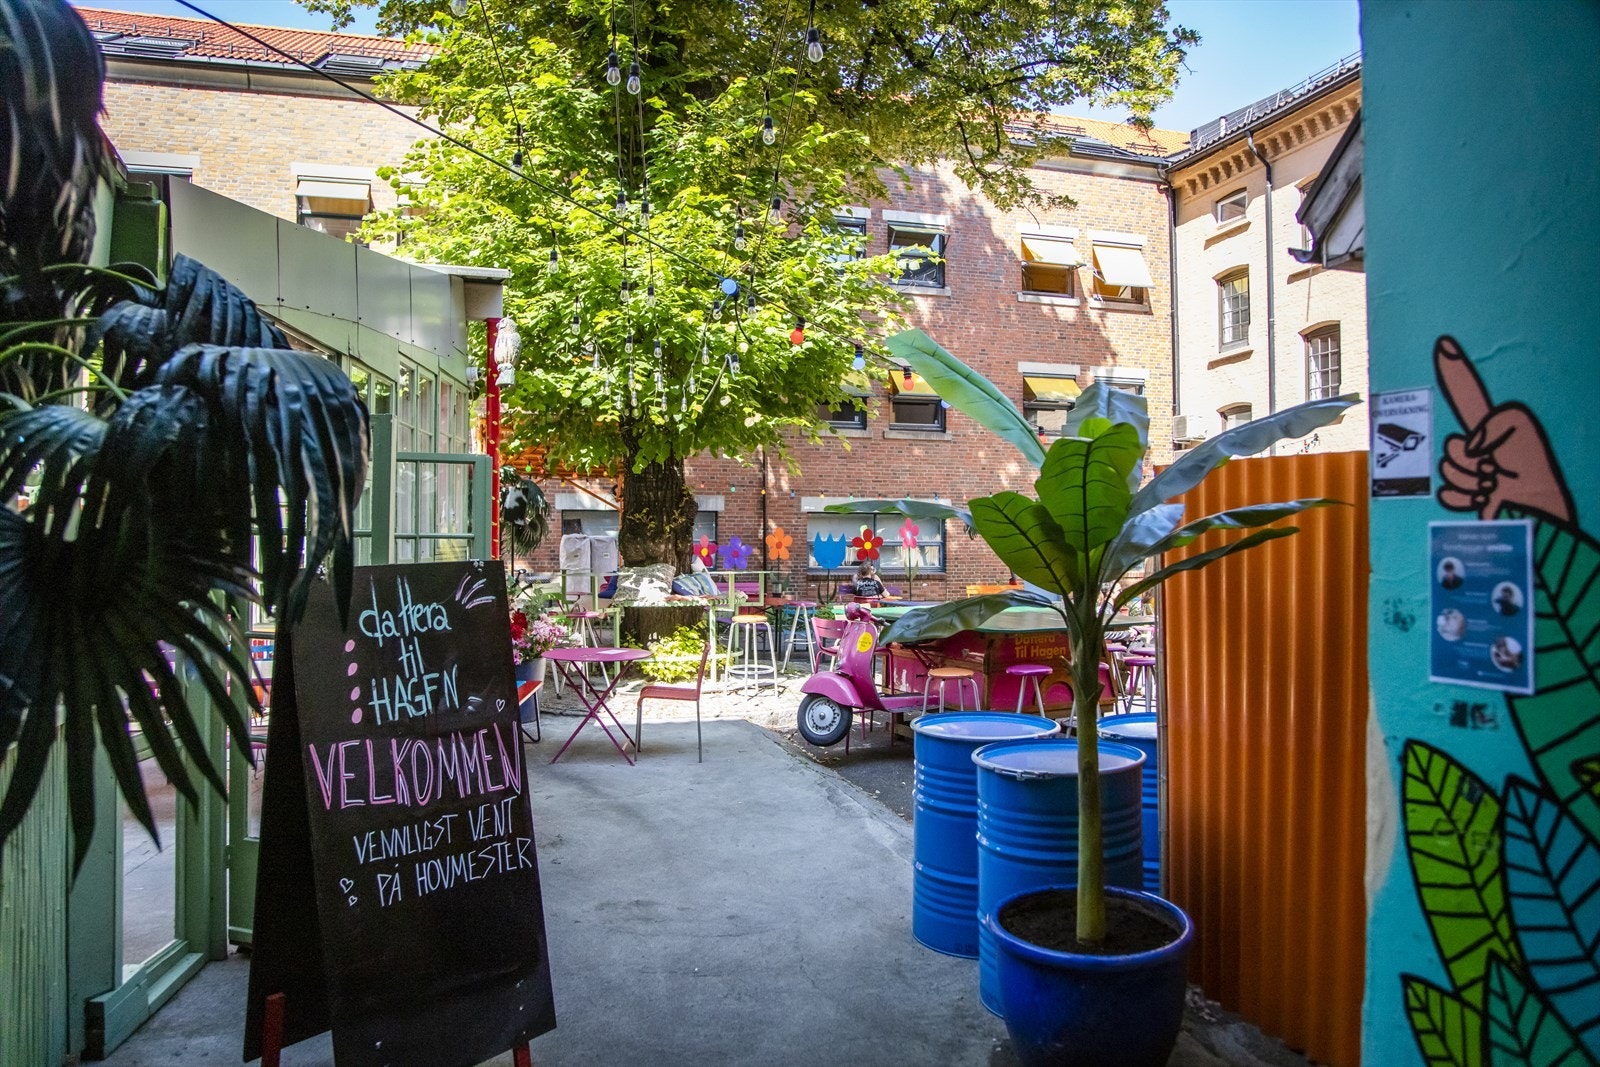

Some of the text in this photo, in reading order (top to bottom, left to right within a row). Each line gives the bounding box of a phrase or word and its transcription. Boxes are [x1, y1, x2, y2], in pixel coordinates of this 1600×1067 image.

[398, 636, 424, 679] til
[1015, 645, 1066, 659] Til Hagen
[309, 720, 522, 810] VELKOMMEN
[353, 796, 518, 864] VENNLIGST VENT
[377, 837, 532, 907] PÅ HOVMESTER
